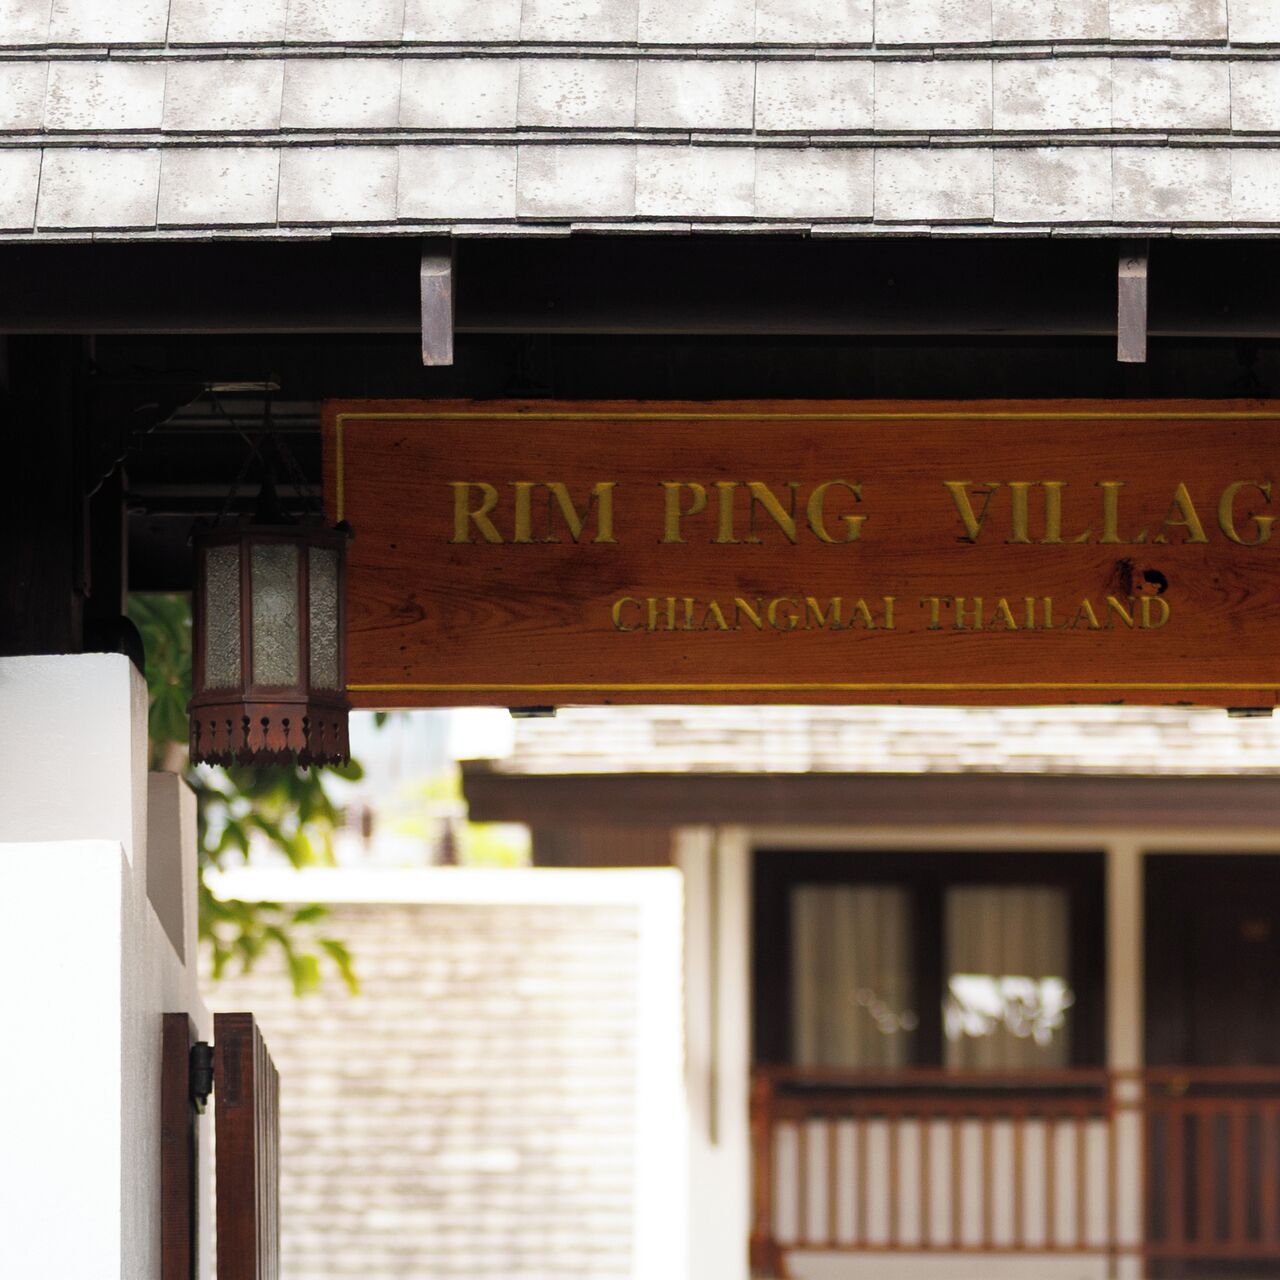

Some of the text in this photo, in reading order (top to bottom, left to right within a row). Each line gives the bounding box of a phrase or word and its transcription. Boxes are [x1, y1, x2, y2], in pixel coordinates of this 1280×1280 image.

[447, 480, 618, 544] RIM
[657, 479, 869, 545] PING
[611, 595, 1171, 632] CHIANGMAI THAILAND
